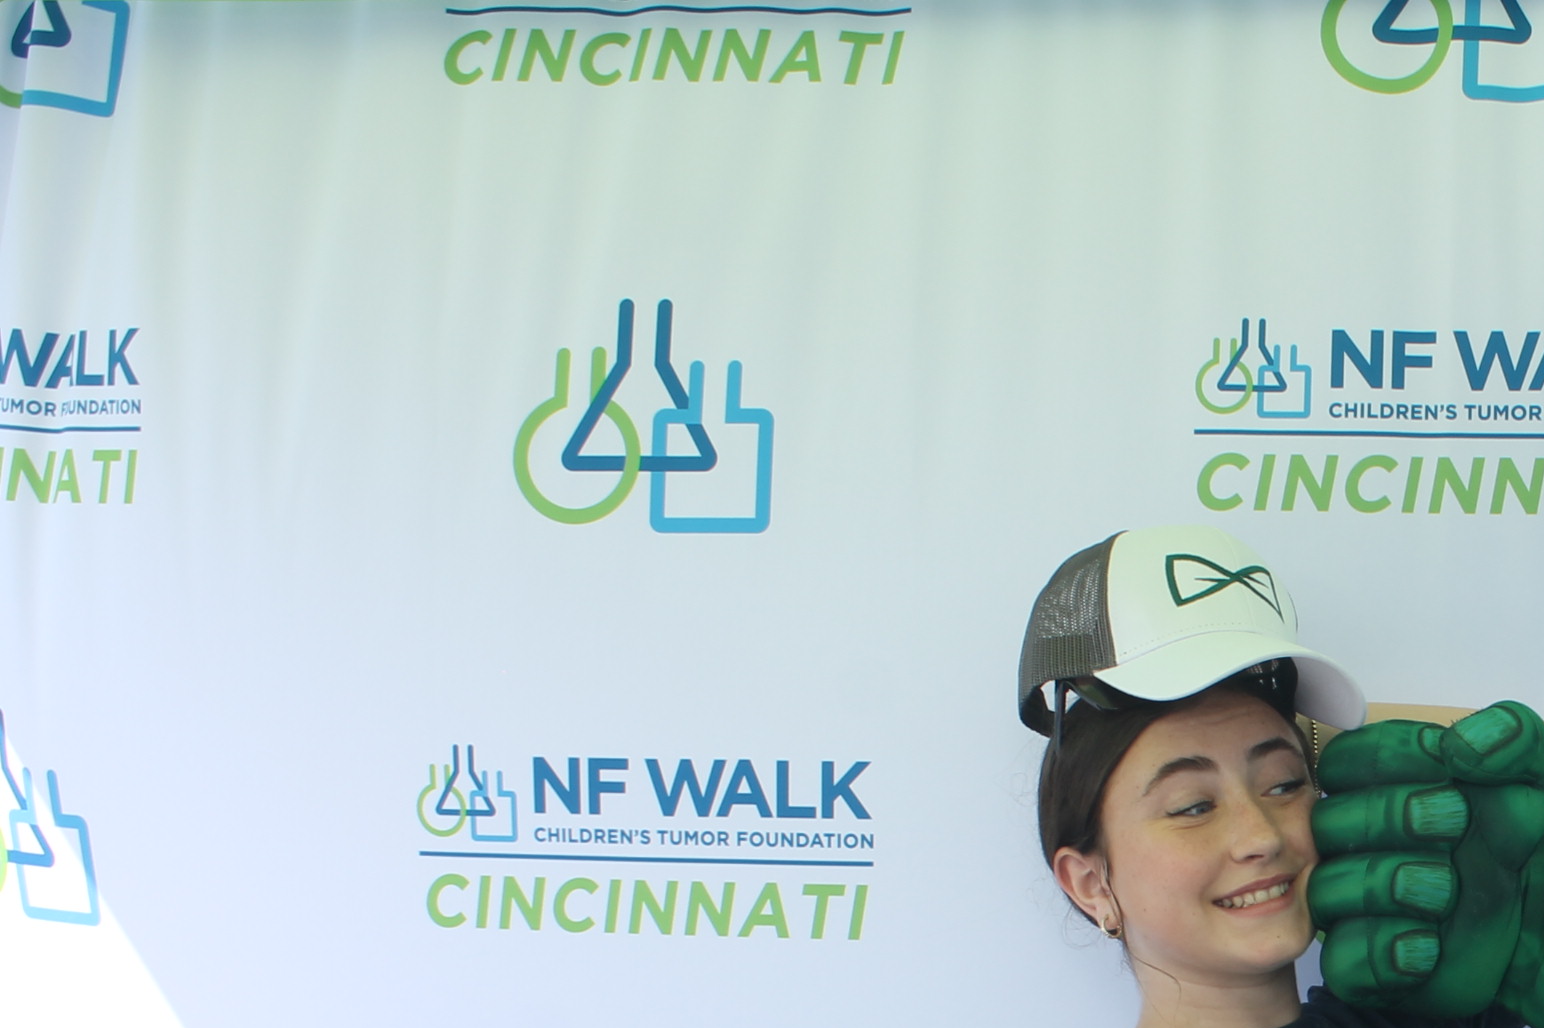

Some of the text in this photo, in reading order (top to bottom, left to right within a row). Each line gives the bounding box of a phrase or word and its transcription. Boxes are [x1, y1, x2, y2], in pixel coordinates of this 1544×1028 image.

[443, 27, 905, 87] CINCINNATI
[1330, 329, 1437, 390] NF
[0, 397, 56, 417] UMOR
[1329, 402, 1458, 421] CHILDREN'S
[1464, 403, 1542, 422] TUMOR
[532, 756, 873, 820] NF WALK
[533, 827, 875, 849] CHILDREN'S TUMOR FOUNDATION
[426, 872, 869, 941] CINCINNATI
